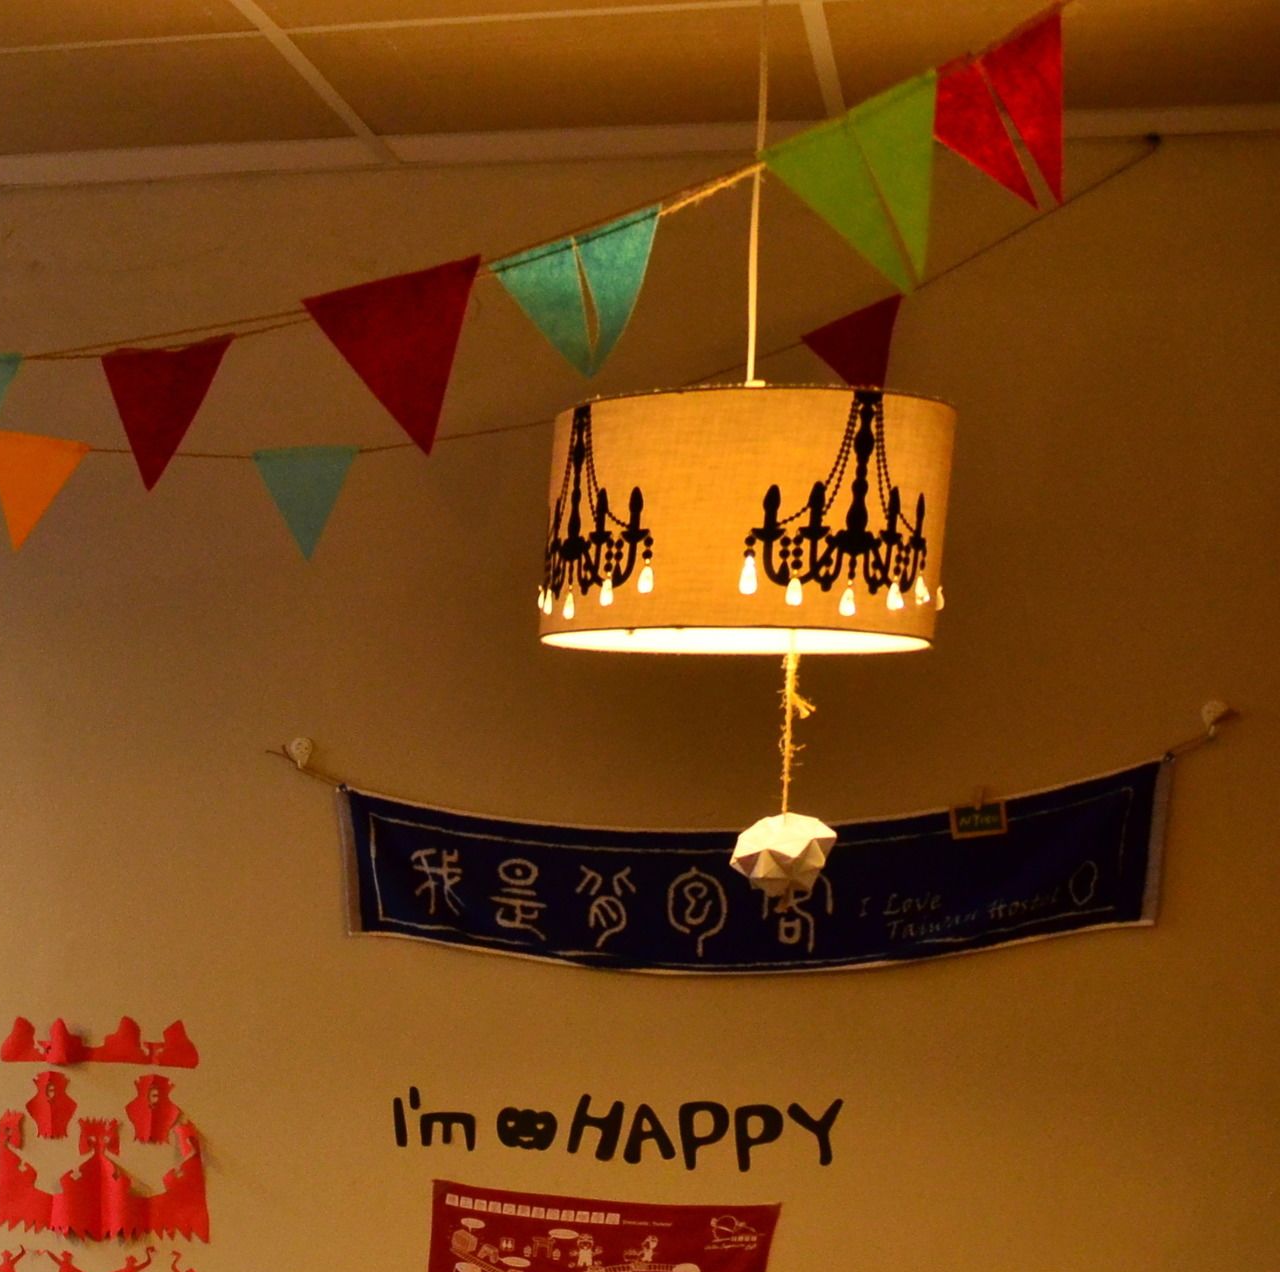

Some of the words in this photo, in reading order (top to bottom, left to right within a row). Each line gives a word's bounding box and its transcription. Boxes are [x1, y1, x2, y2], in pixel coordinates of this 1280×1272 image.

[883, 891, 944, 917] Love
[392, 1086, 477, 1151] I'm
[566, 1093, 844, 1172] HAPPY
